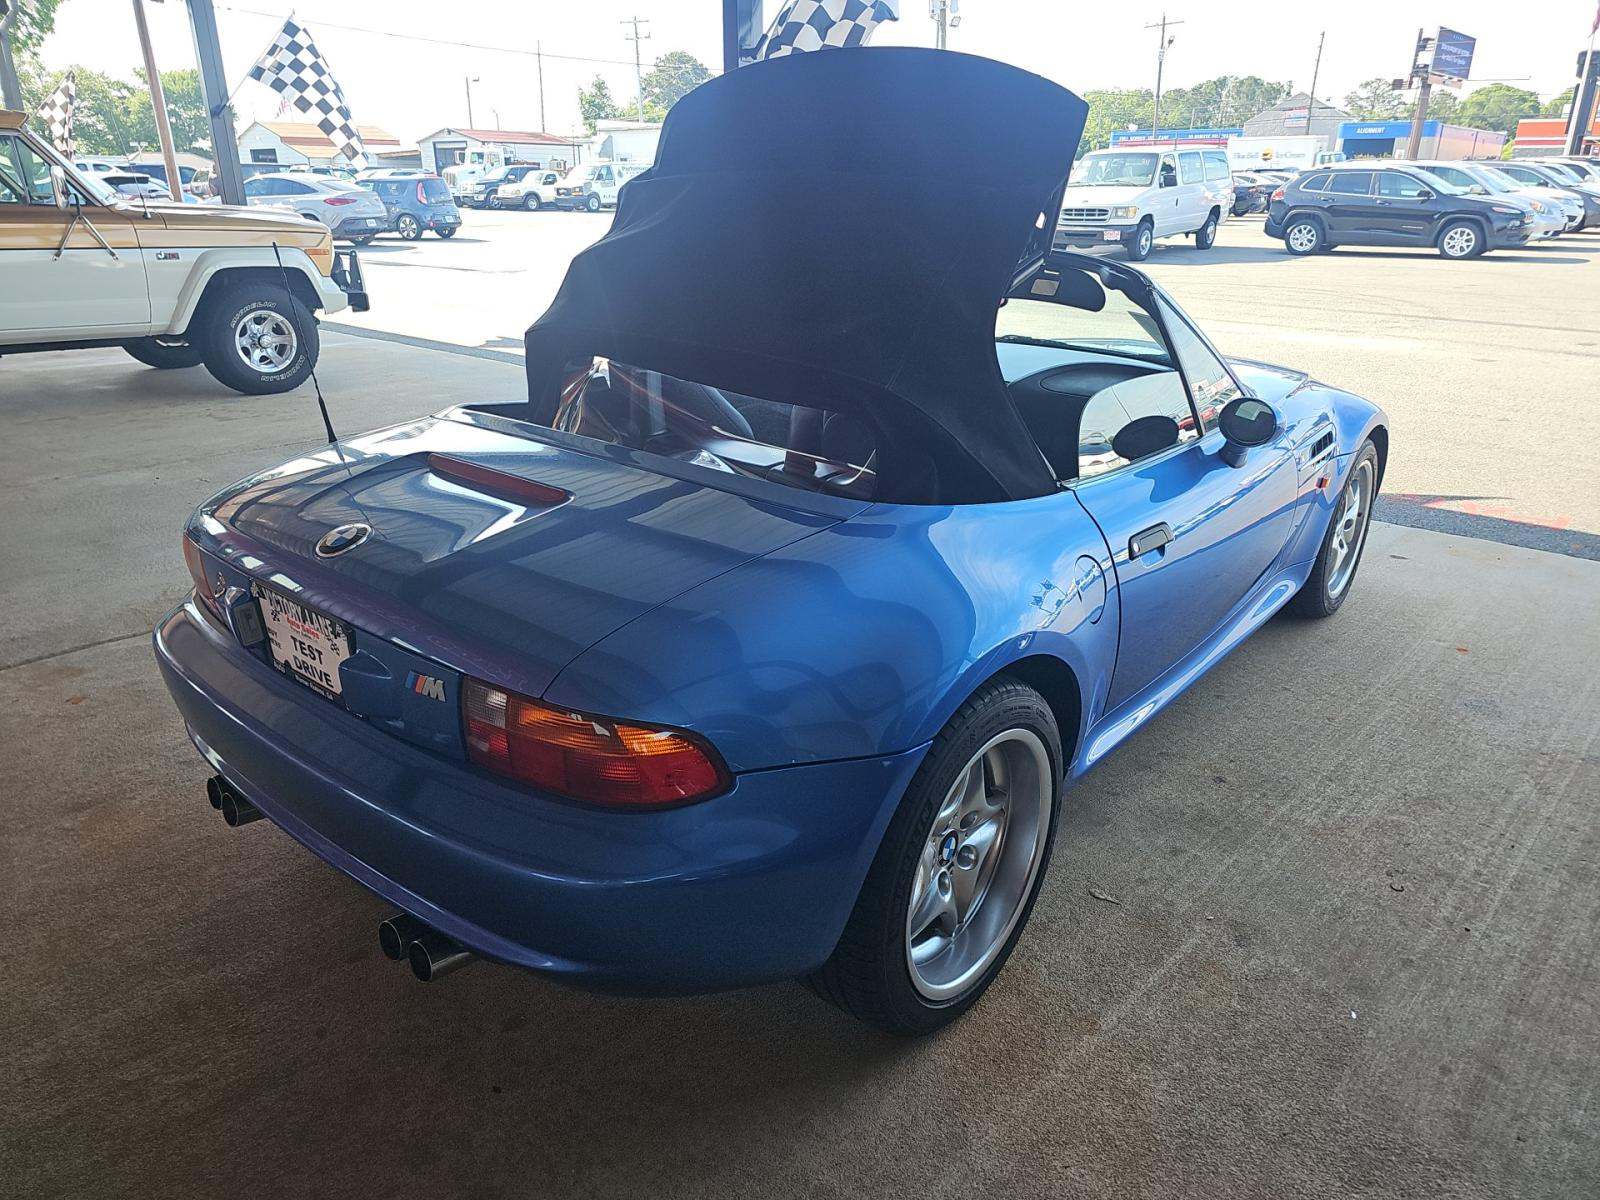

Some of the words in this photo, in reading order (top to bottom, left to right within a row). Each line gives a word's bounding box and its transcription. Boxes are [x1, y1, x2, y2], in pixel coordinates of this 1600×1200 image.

[230, 301, 276, 329] MICHELIN
[260, 586, 303, 624] VICTORY
[304, 608, 336, 640] LANE
[290, 635, 323, 665] TEST
[293, 654, 334, 688] DRIVE
